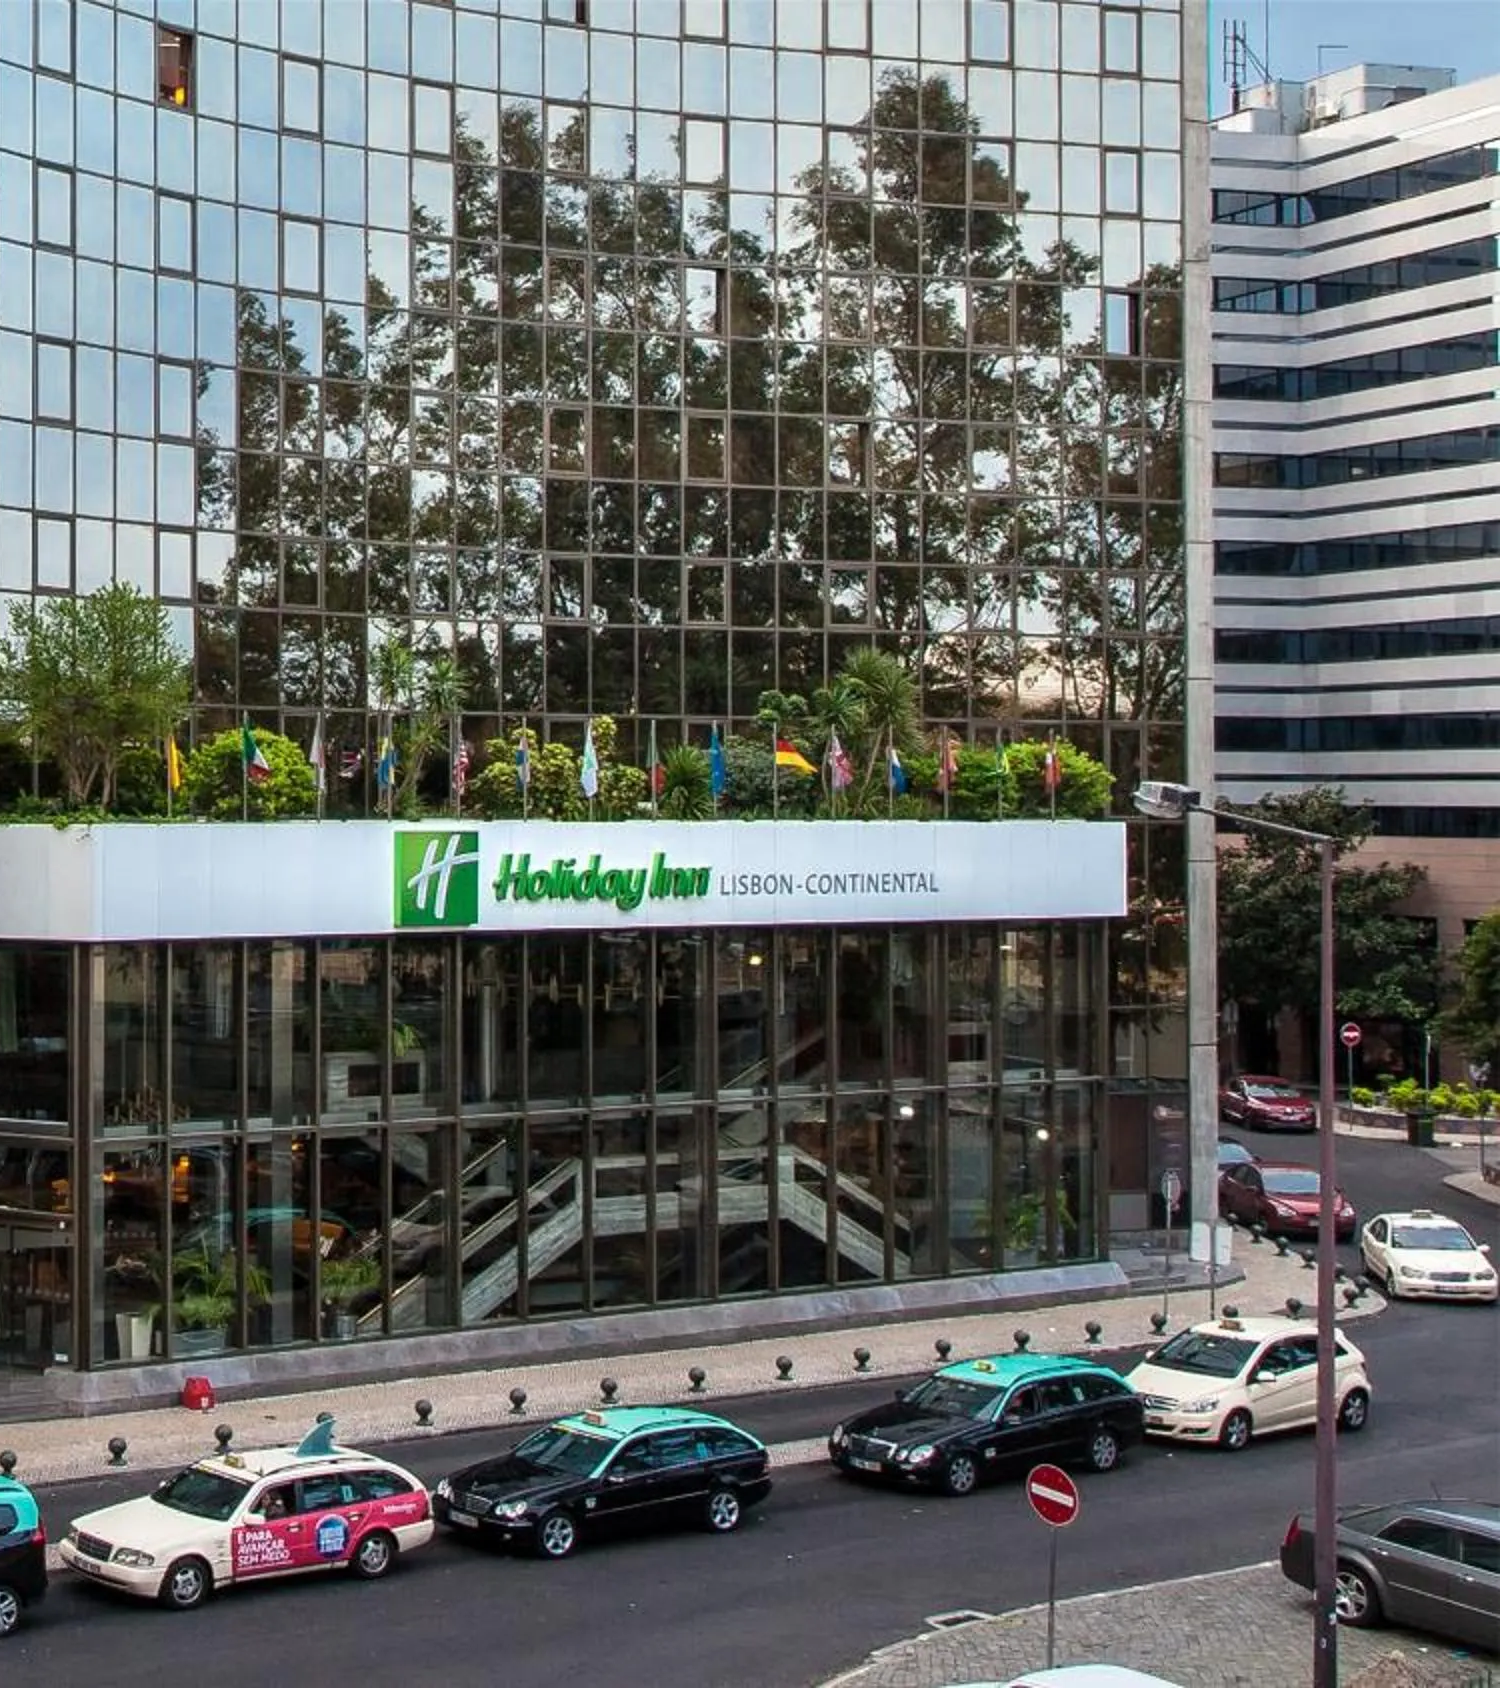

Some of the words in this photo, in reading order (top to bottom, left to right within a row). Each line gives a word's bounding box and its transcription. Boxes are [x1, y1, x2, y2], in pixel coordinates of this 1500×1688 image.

[492, 853, 649, 912] Holiday
[649, 852, 712, 899] Inn
[720, 872, 939, 896] LISBON-CONTINENTAL
[245, 1529, 272, 1543] PARA
[237, 1554, 259, 1566] SEM
[260, 1549, 290, 1562] MEDO
